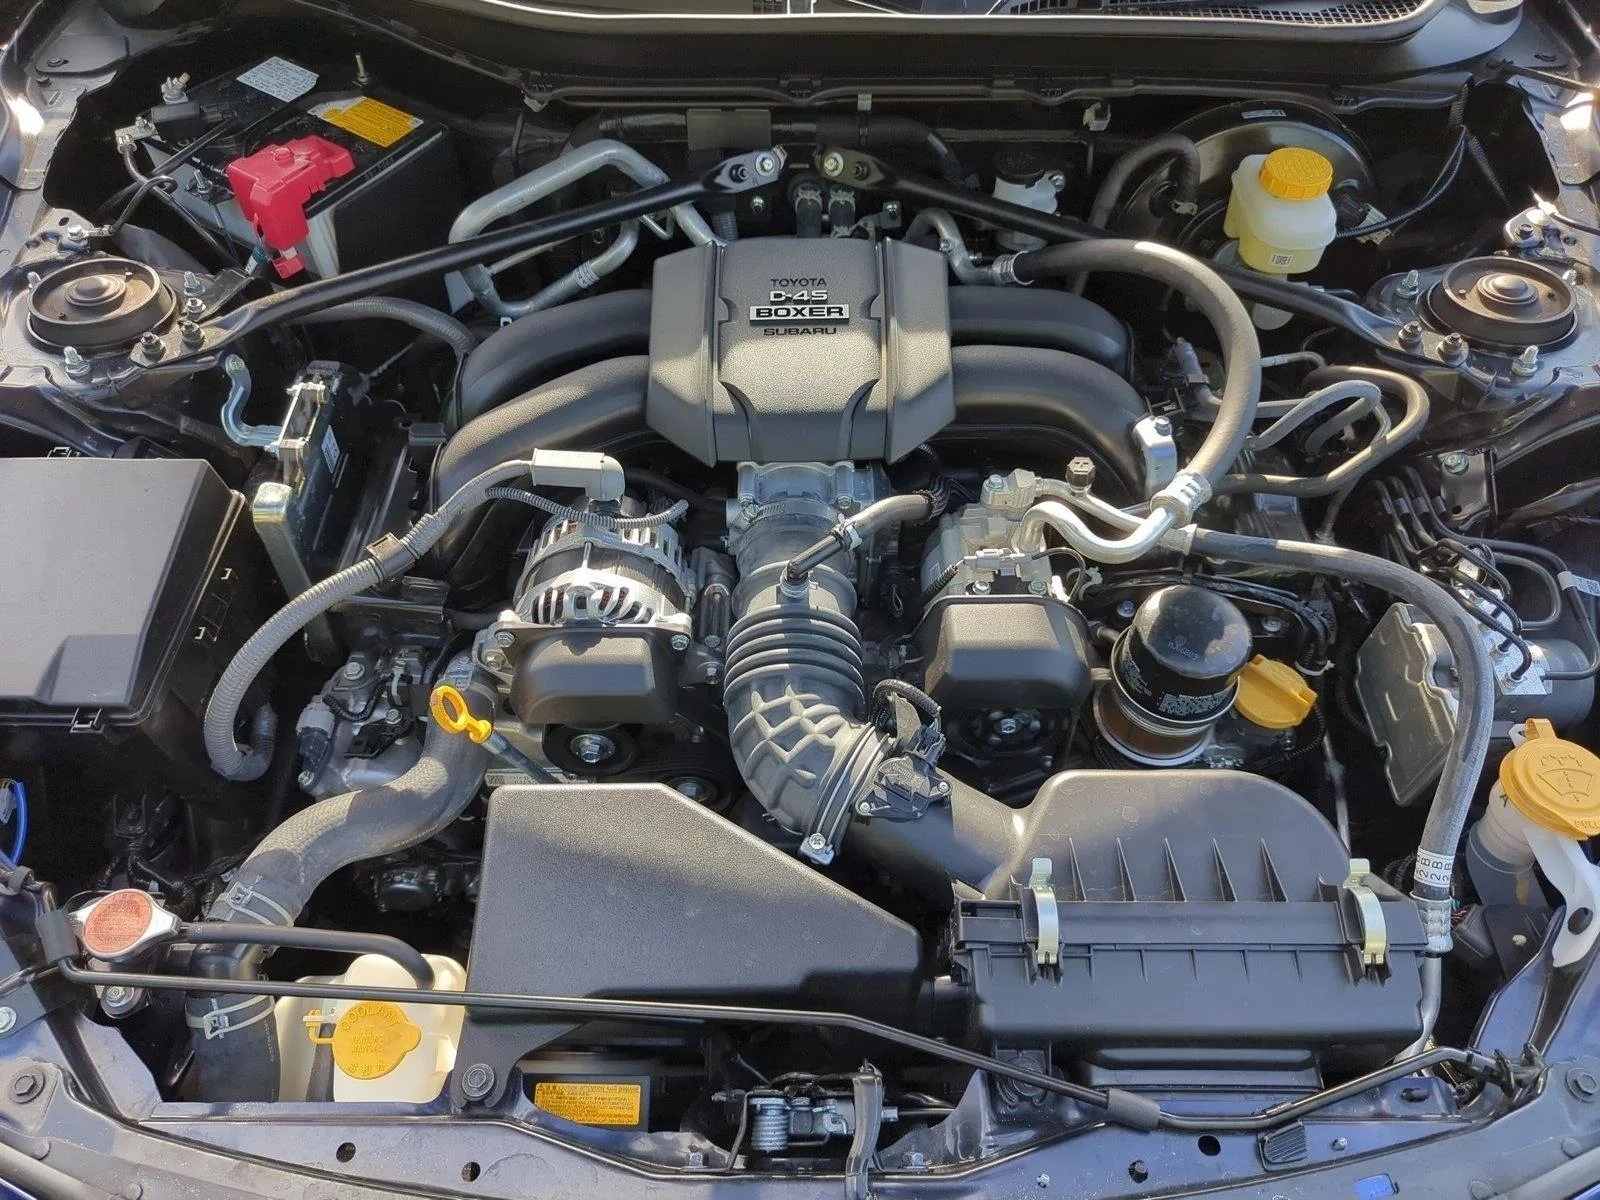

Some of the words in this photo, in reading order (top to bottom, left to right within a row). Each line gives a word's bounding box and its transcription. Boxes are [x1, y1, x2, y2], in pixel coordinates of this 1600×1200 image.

[770, 278, 827, 287] TOYOTA
[769, 290, 828, 301] D-4S
[755, 306, 844, 318] BOXER
[763, 327, 837, 336] SUBARU
[340, 1005, 401, 1031] COOLANT
